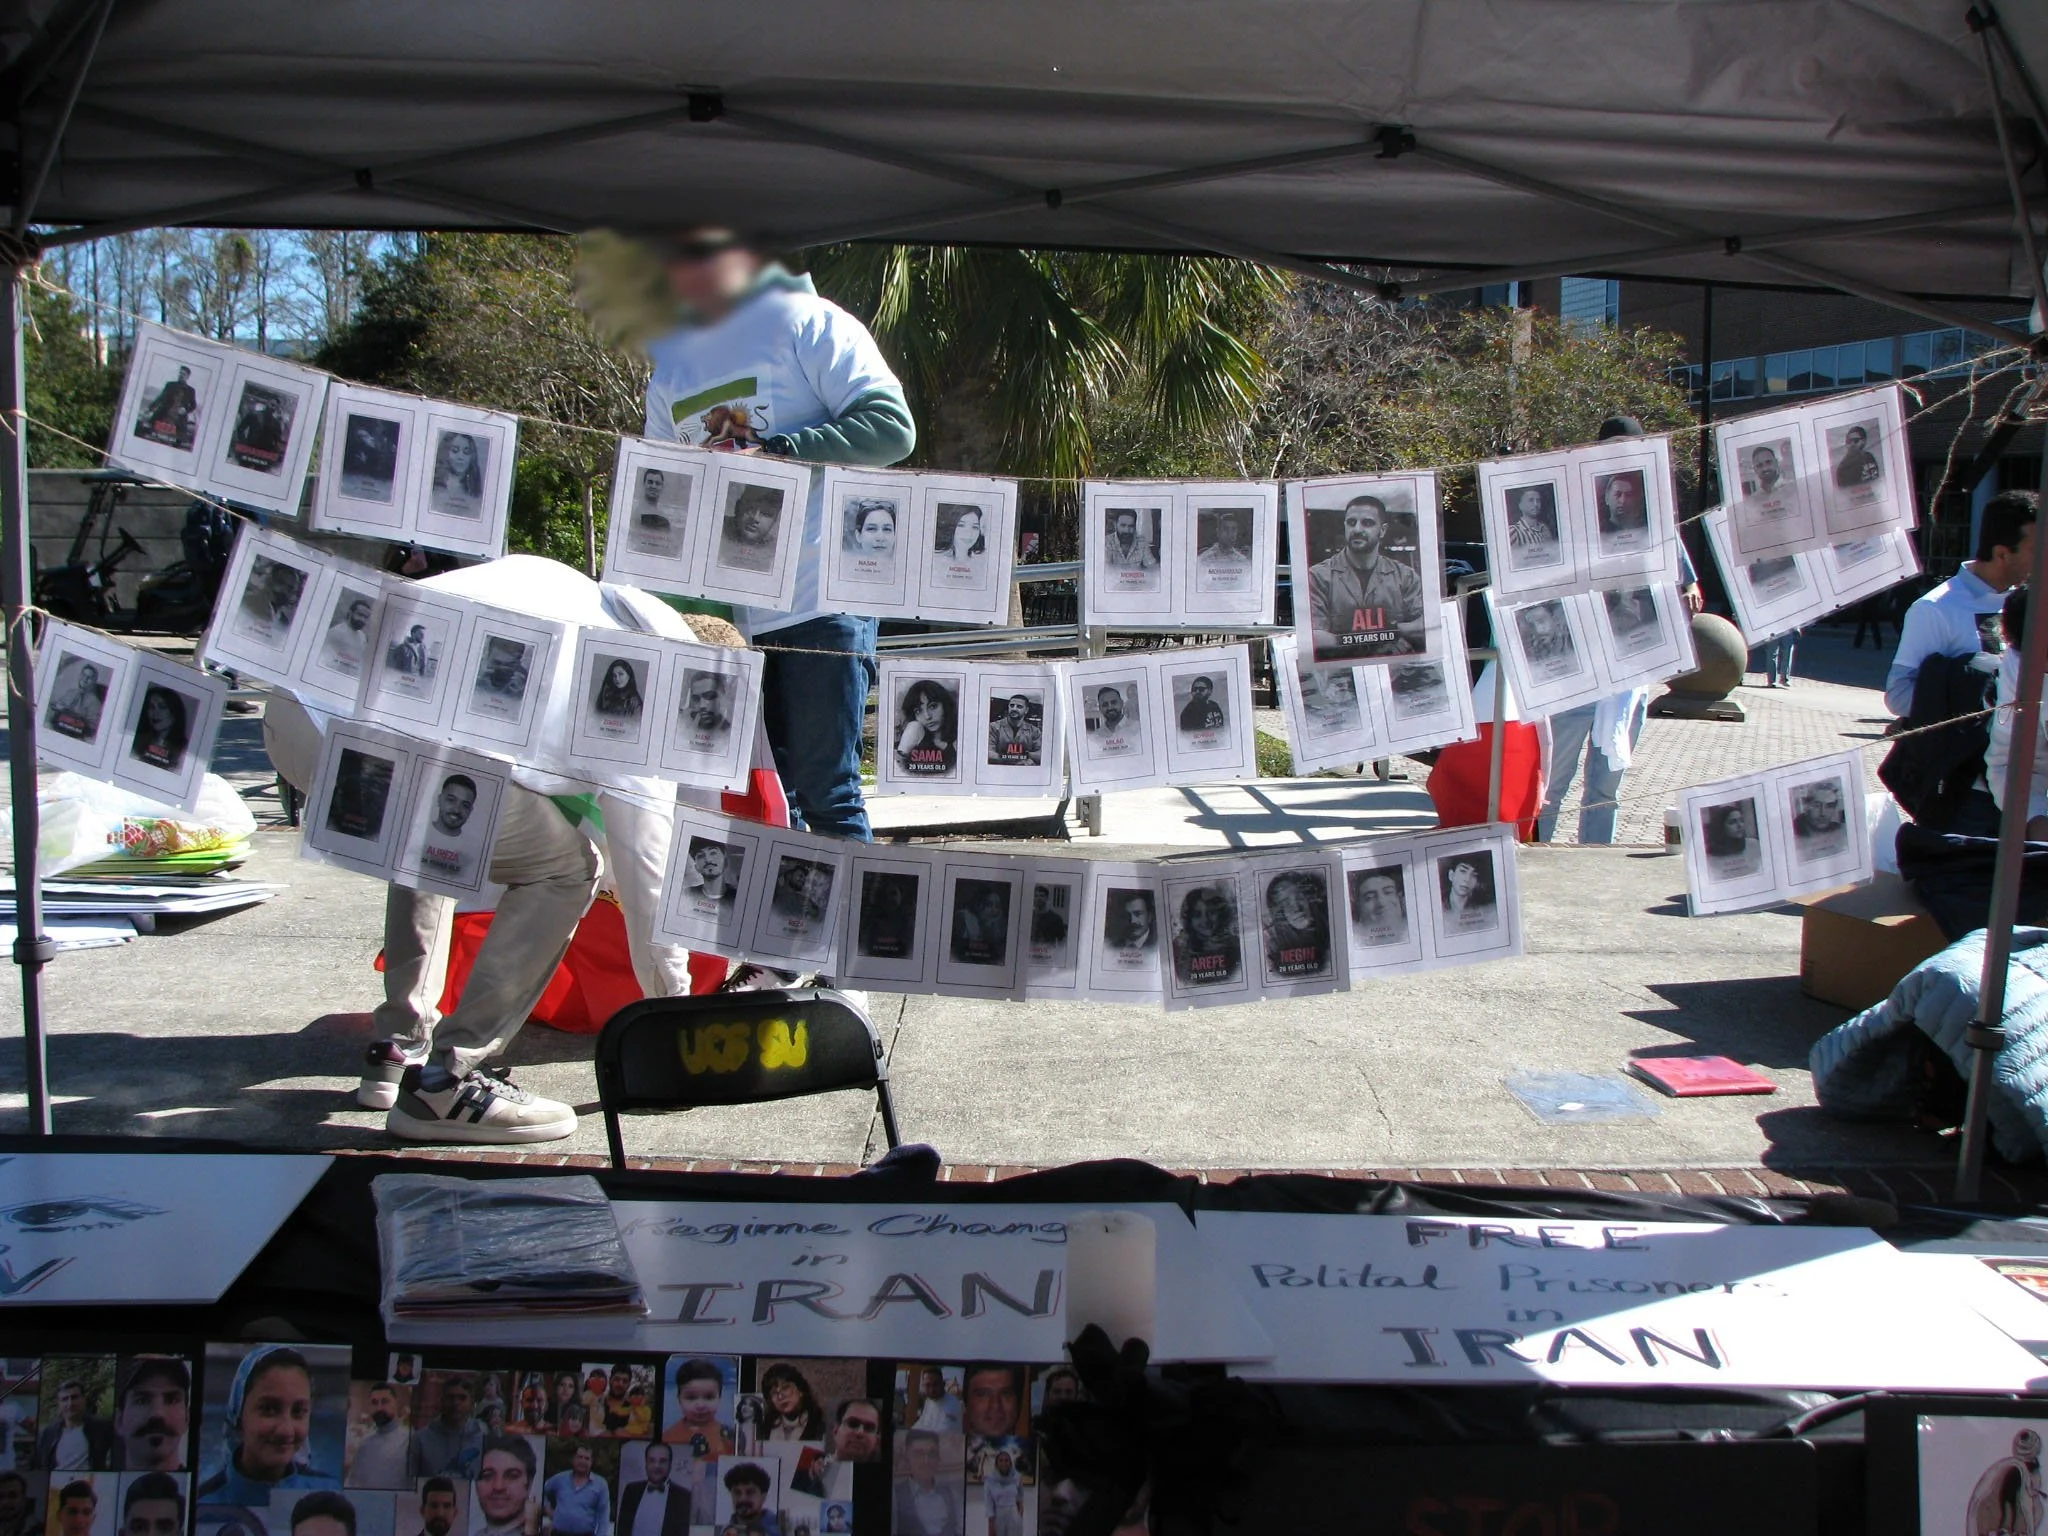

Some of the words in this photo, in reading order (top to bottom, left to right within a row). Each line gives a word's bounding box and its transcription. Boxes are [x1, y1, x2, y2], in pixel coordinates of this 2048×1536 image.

[1352, 607, 1385, 631] ALI
[1342, 636, 1352, 644] 33
[1354, 633, 1378, 644] YEARS
[1380, 632, 1395, 641] OLD
[911, 749, 943, 763] SAMA
[1007, 743, 1023, 754] ALI
[1191, 954, 1225, 971] AREFE
[1280, 946, 1316, 962] NEGIN
[1199, 971, 1216, 979] YEARS
[620, 1216, 853, 1247] Regime
[867, 1213, 1068, 1244] Chang
[1406, 1221, 1650, 1251] FREE
[792, 1245, 849, 1267] in
[638, 1269, 1062, 1327] IRAN
[1505, 1303, 1564, 1323] in
[1381, 1326, 1729, 1369] IRAN
